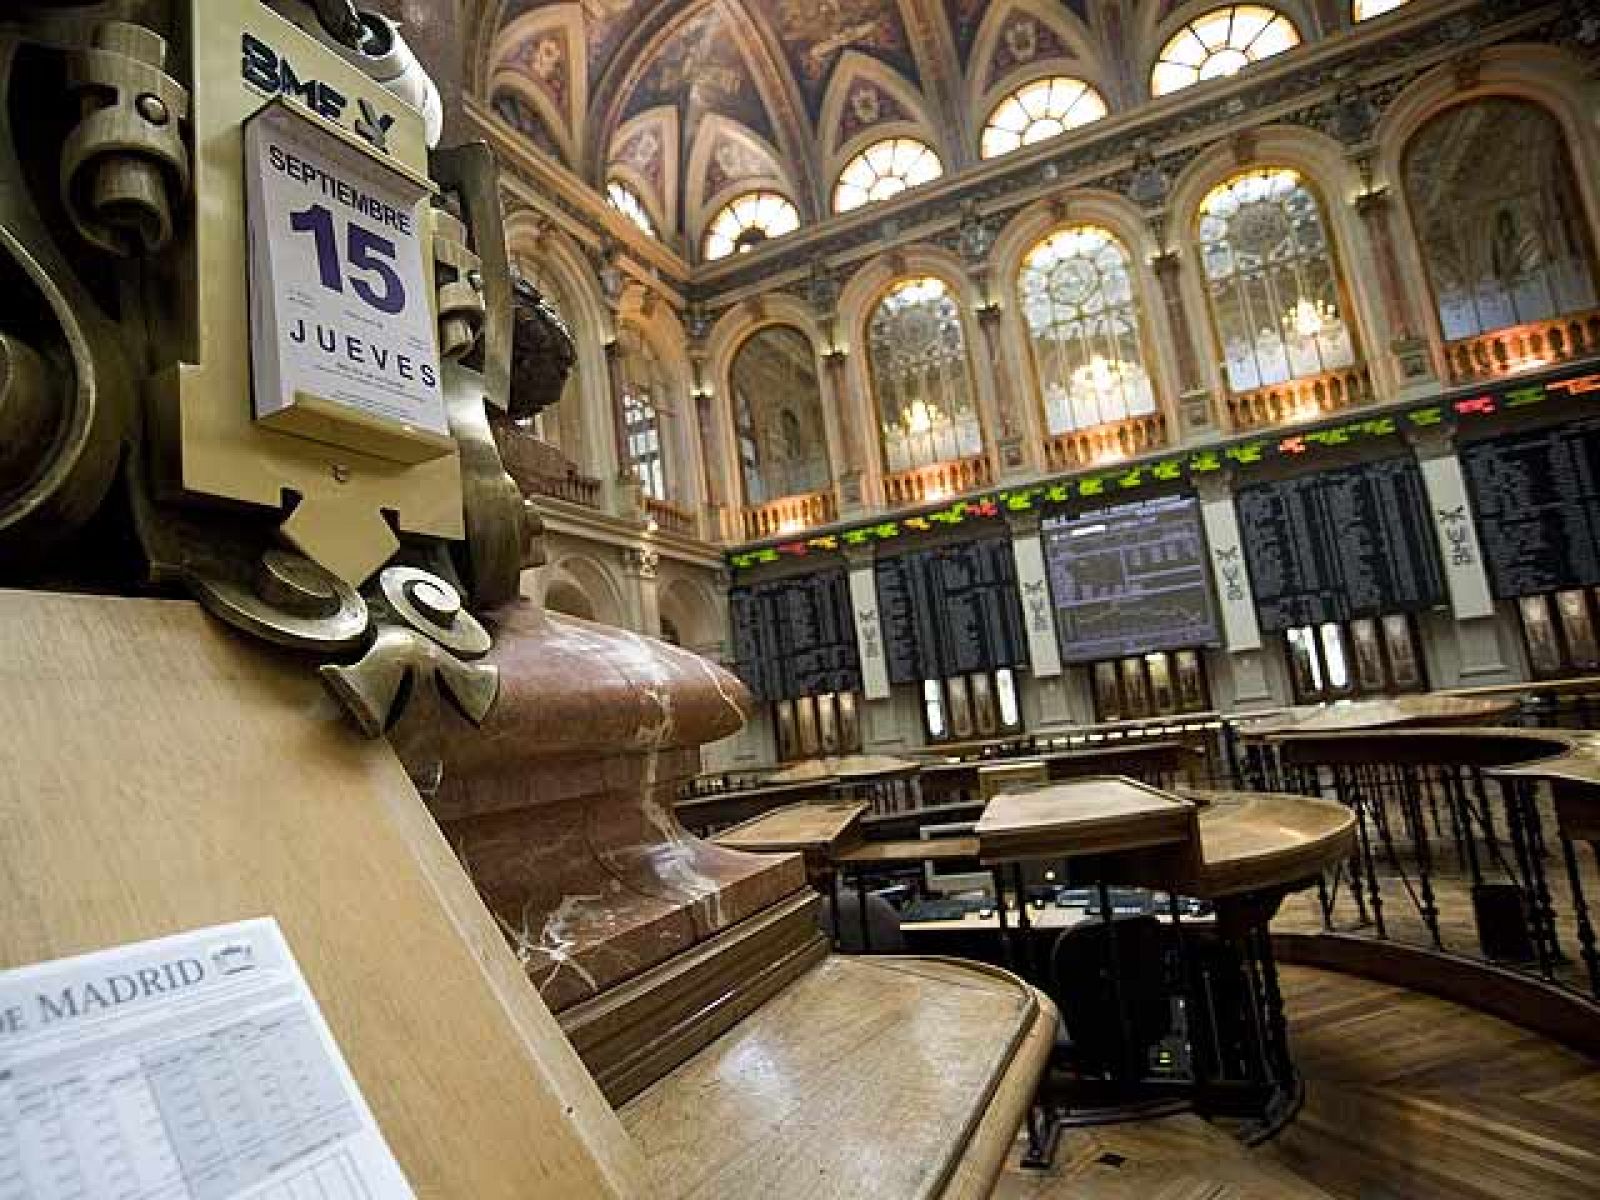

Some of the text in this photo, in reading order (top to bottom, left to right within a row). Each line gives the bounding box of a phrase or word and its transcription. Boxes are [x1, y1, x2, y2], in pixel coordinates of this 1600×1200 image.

[269, 144, 411, 236] SEPTIEMBRE
[290, 203, 406, 314] 15
[289, 319, 437, 388] JUEVES
[36, 959, 204, 1023] MADRID
